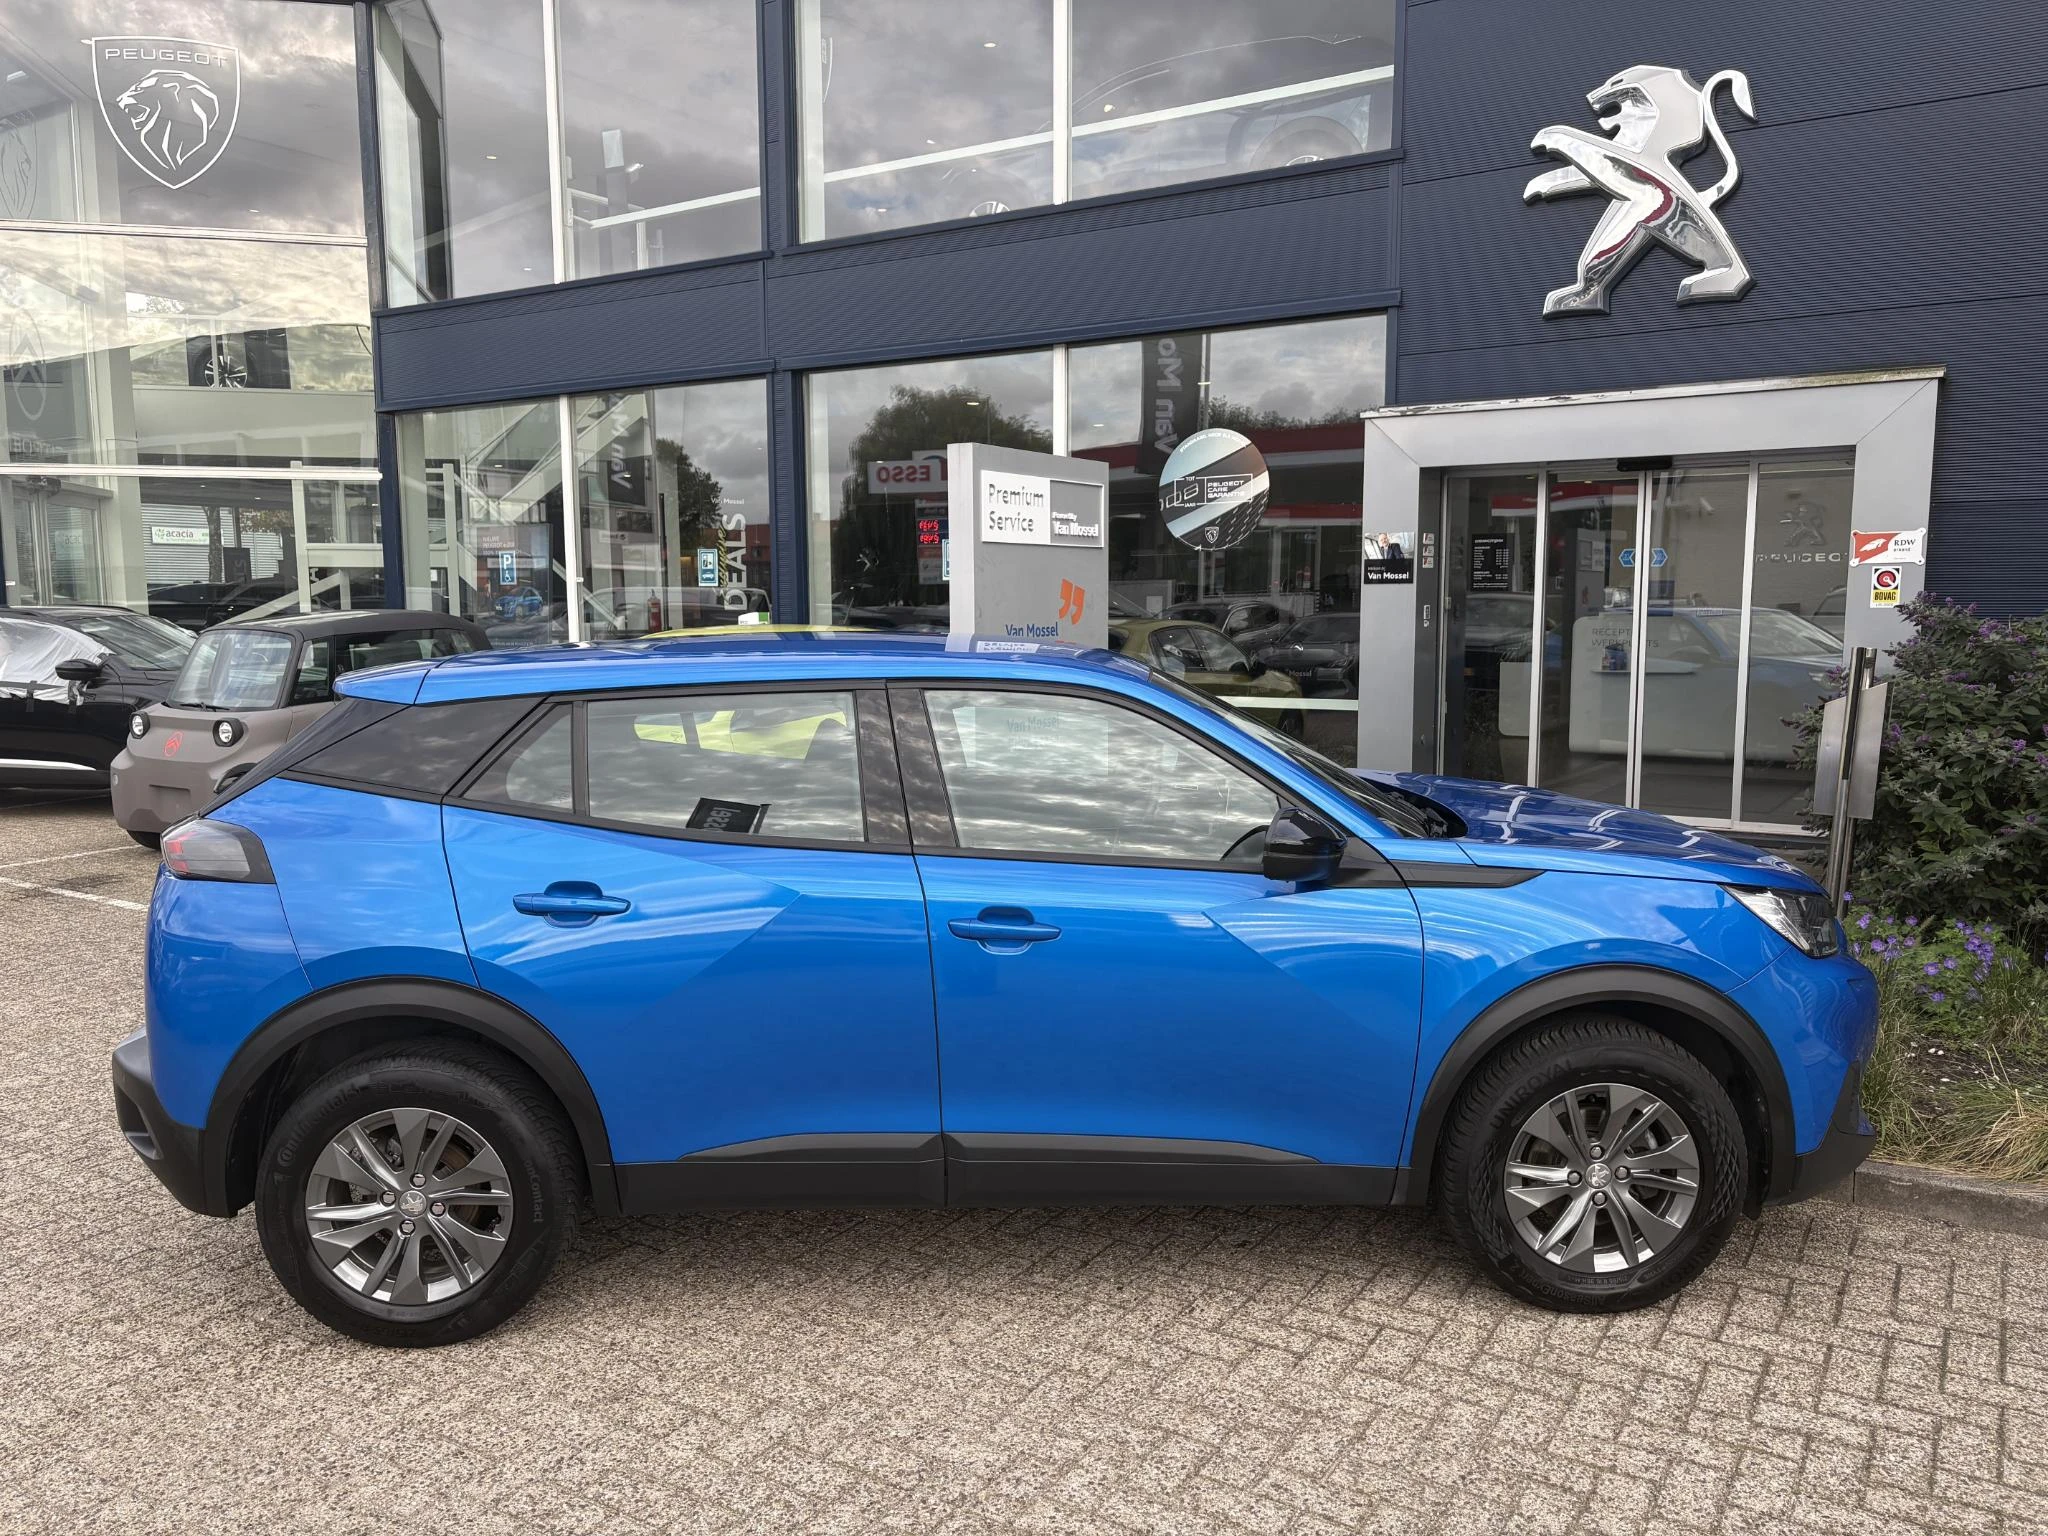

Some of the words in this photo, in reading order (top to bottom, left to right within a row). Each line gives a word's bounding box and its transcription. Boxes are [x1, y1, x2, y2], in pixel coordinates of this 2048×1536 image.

[104, 48, 228, 68] PEUGEOT
[1207, 480, 1245, 488] PEUGEOT
[988, 483, 1044, 508] Premium
[989, 510, 1034, 532] Service
[1052, 520, 1069, 535] Van
[1070, 522, 1099, 537] Mossel
[165, 529, 194, 538] acacia
[1894, 539, 1916, 547] RDW
[503, 554, 512, 570] P
[722, 513, 748, 611] DEALS
[1755, 552, 1848, 563] PEUGEO
[1367, 572, 1382, 580] Van
[1383, 571, 1409, 580] Mossel
[1874, 591, 1896, 601] BOVAG
[1005, 623, 1024, 637] Van
[1026, 621, 1059, 638] Mossel
